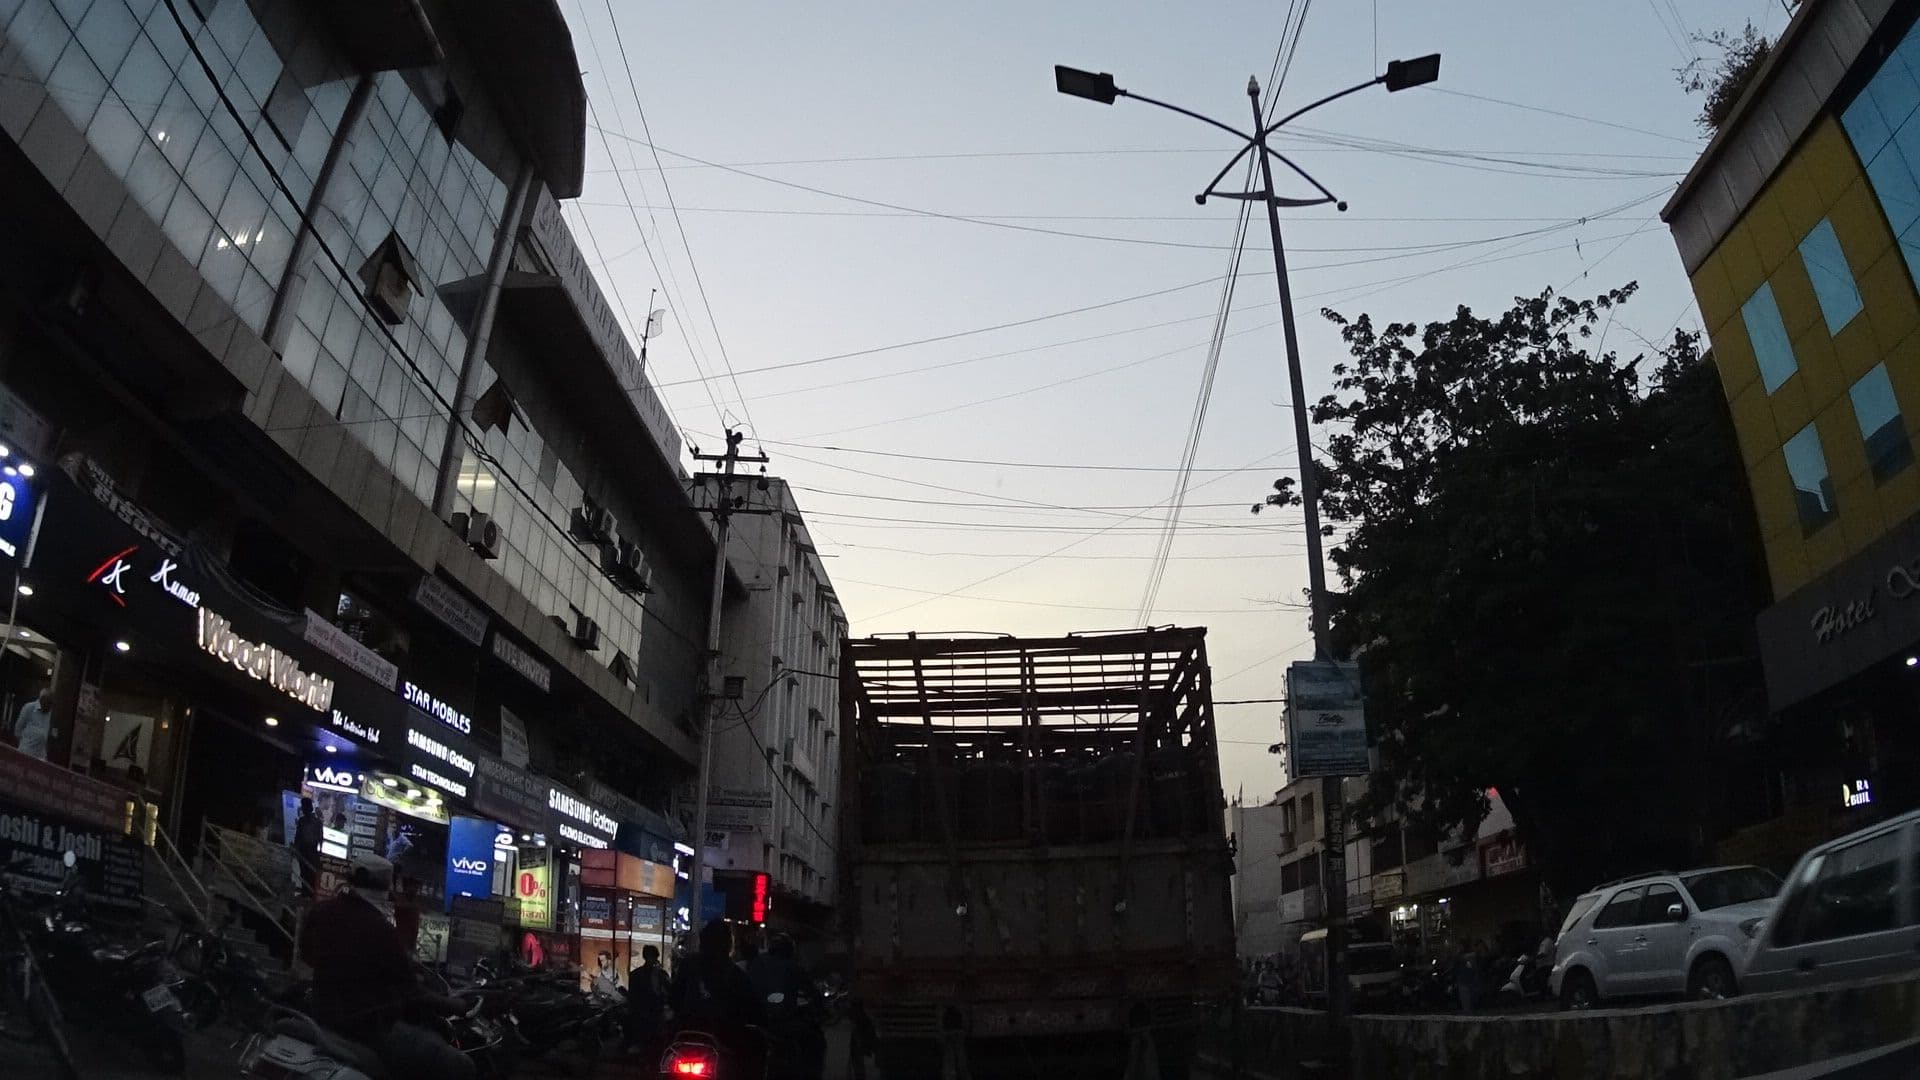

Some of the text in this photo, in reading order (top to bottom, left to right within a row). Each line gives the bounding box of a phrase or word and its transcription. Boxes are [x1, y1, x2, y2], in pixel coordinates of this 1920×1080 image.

[149, 558, 200, 608] Kumar
[198, 605, 267, 681] Wood
[267, 647, 334, 712] World
[403, 681, 471, 735] STAR MOBILES
[408, 728, 475, 778] SAMSUNG Galaxy
[314, 766, 352, 786] vivo
[412, 763, 427, 780] STAR
[427, 770, 467, 798] TECHNOLOGIES
[548, 788, 591, 824] SAMSUNG
[592, 809, 618, 840] Galaxy
[42, 825, 55, 850] &
[56, 824, 101, 862] Joshi
[452, 856, 487, 871] vivo
[520, 873, 546, 898] 0%
